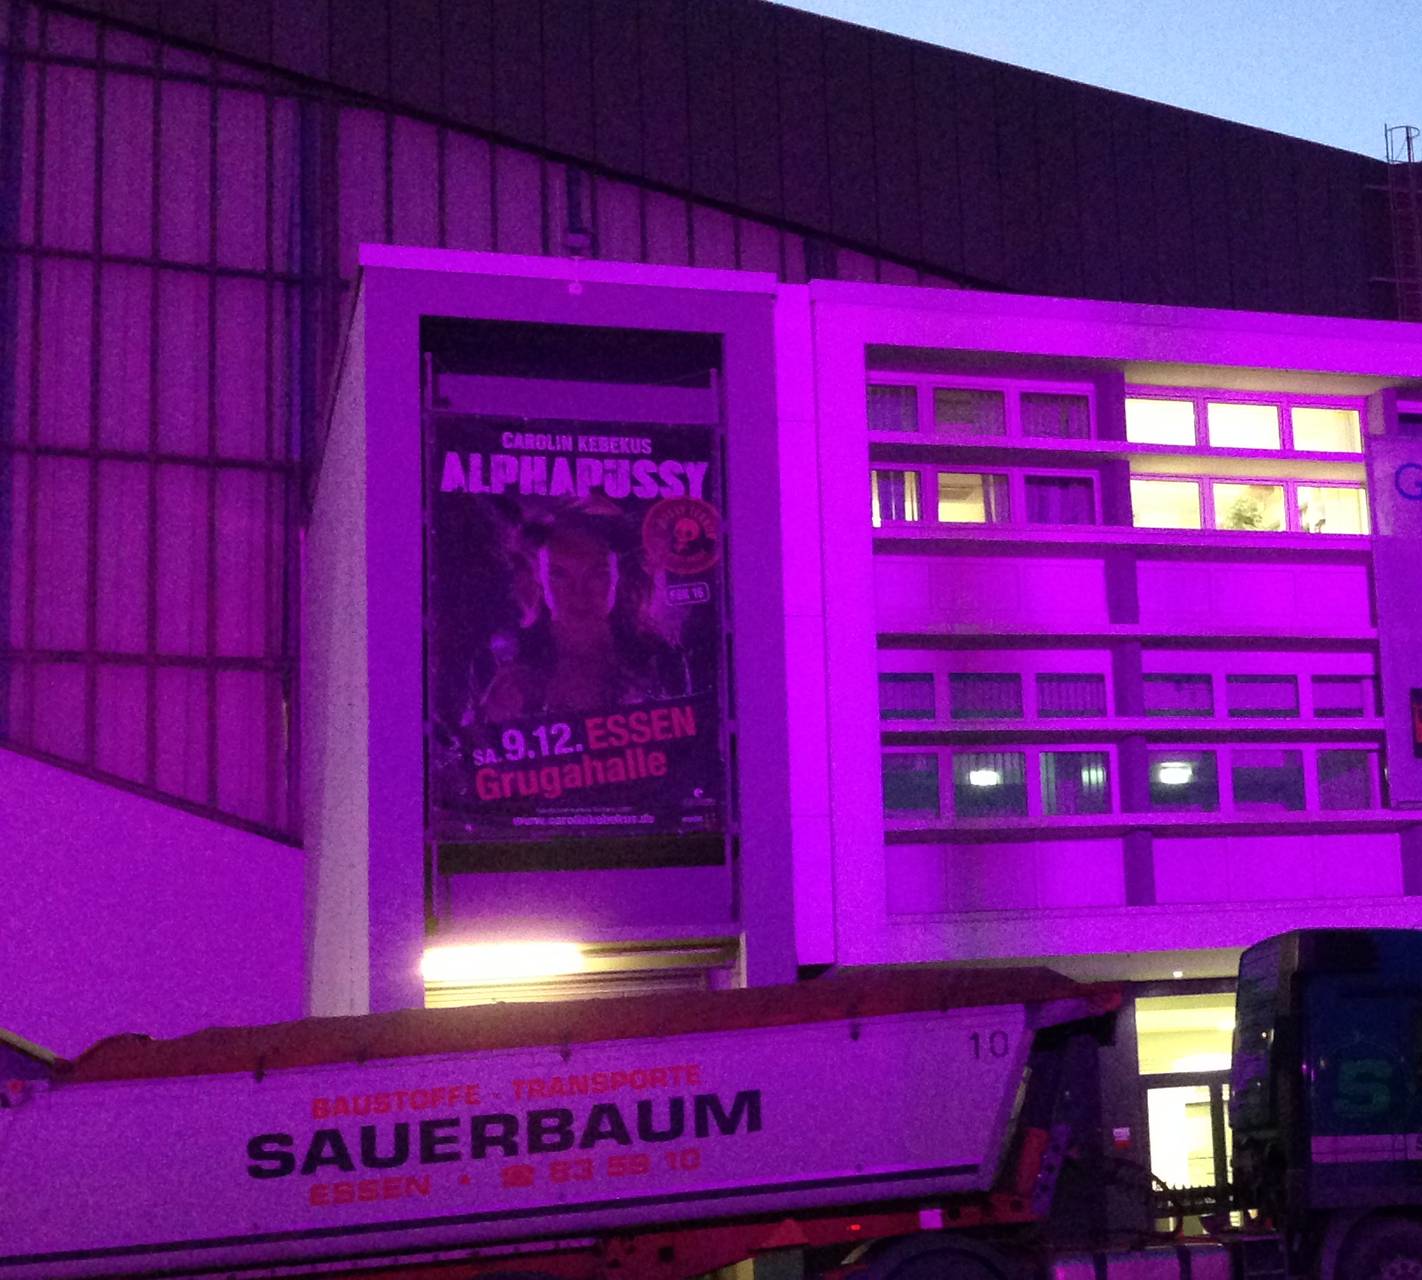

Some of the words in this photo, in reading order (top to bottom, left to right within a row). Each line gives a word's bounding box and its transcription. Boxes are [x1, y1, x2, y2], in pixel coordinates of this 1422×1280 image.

[501, 431, 574, 452] CAROLIN
[578, 435, 653, 455] KEBEKUS
[502, 722, 584, 761] 9.12.
[584, 706, 697, 750] ESSEN
[475, 748, 668, 800] Grugahalle
[969, 1029, 1009, 1059] 10
[311, 1083, 482, 1120] BAUSTOFFE
[512, 1063, 701, 1101] TRANSPORTE
[246, 1089, 763, 1180] SAUERBAUM
[309, 1172, 431, 1207] ESSEN
[666, 1148, 701, 1171] 10
